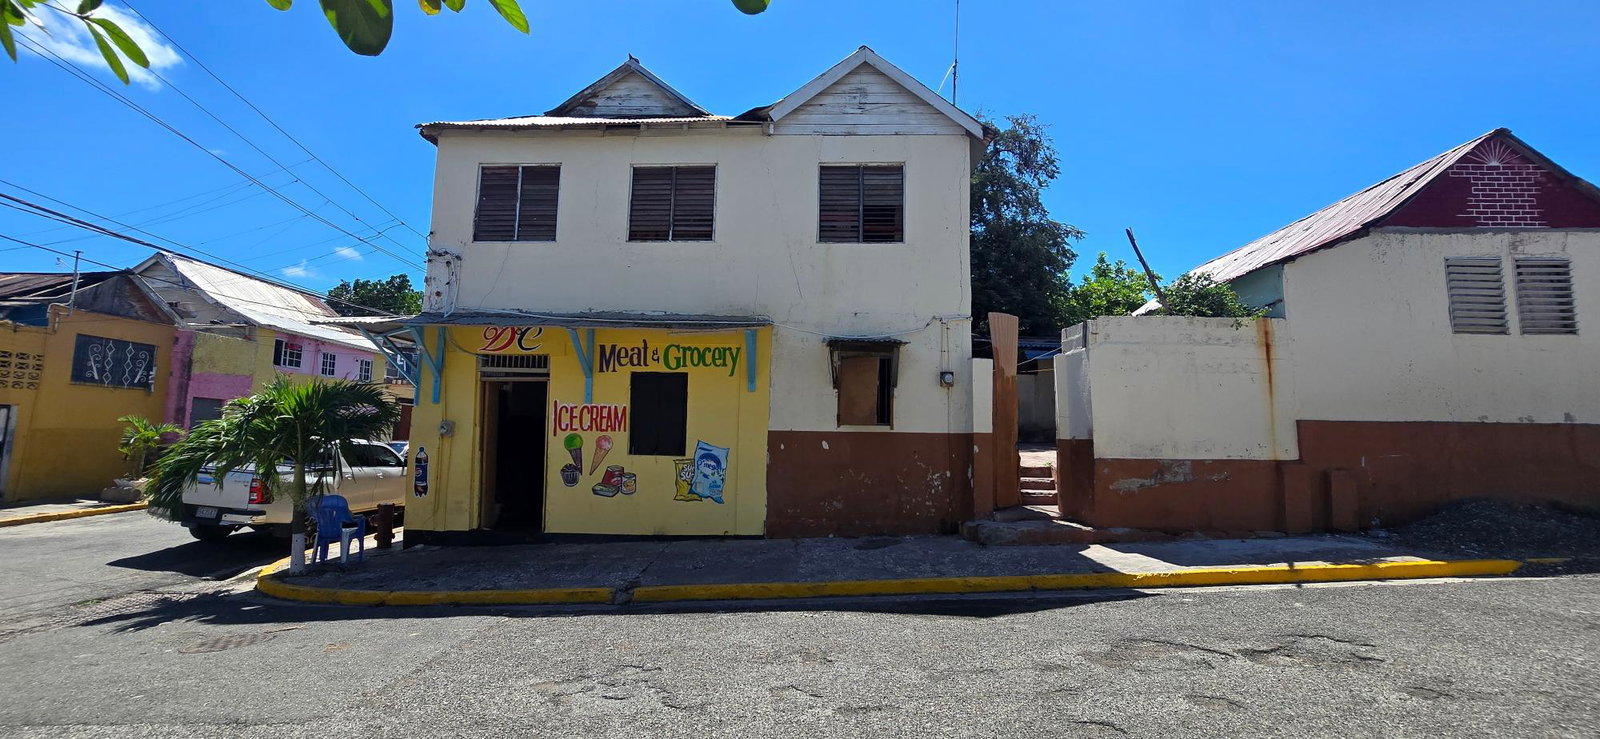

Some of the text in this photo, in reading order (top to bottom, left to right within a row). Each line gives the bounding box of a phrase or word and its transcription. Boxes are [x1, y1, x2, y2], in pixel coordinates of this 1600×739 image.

[598, 338, 741, 377] Meat & Grocery
[553, 399, 627, 437] ICE CREAM
